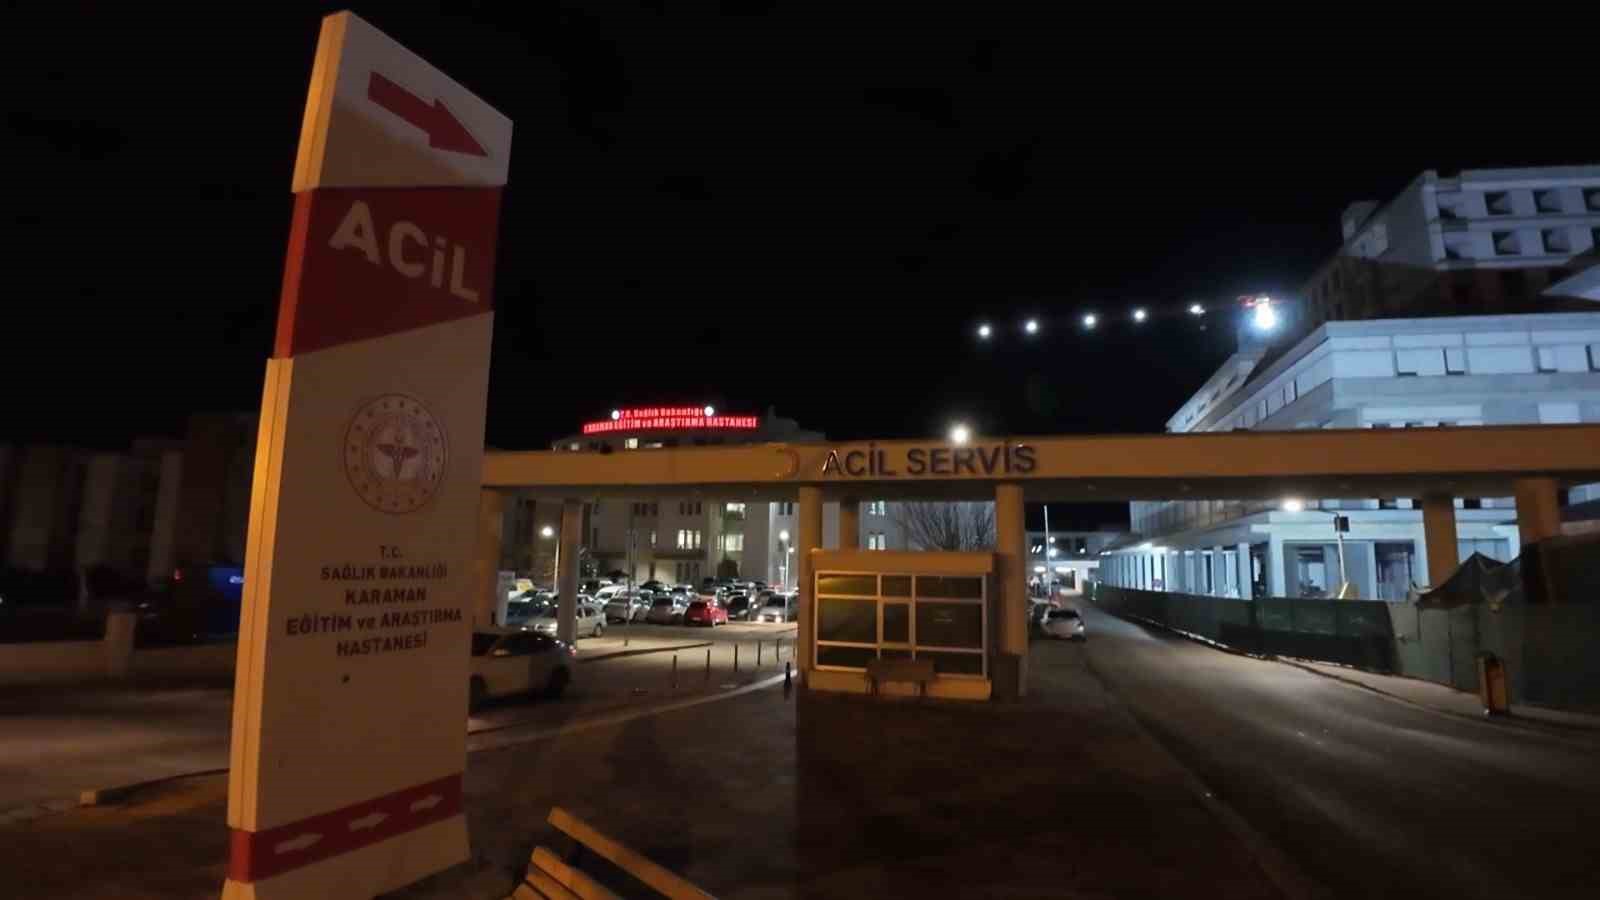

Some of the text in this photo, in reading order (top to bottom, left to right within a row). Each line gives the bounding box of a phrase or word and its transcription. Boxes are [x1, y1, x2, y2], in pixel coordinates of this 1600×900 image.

[653, 416, 704, 429] ARAŞTIRMA
[823, 440, 1036, 476] ACİL SERVİS
[380, 545, 403, 559] T.C.
[321, 562, 448, 581] SAĞLIK BAKANLIĞI
[345, 588, 427, 605] KARAMAN
[286, 608, 462, 636] EĞİTİM ve ARAŞTIRMA
[336, 632, 427, 656] HASTANESİ
